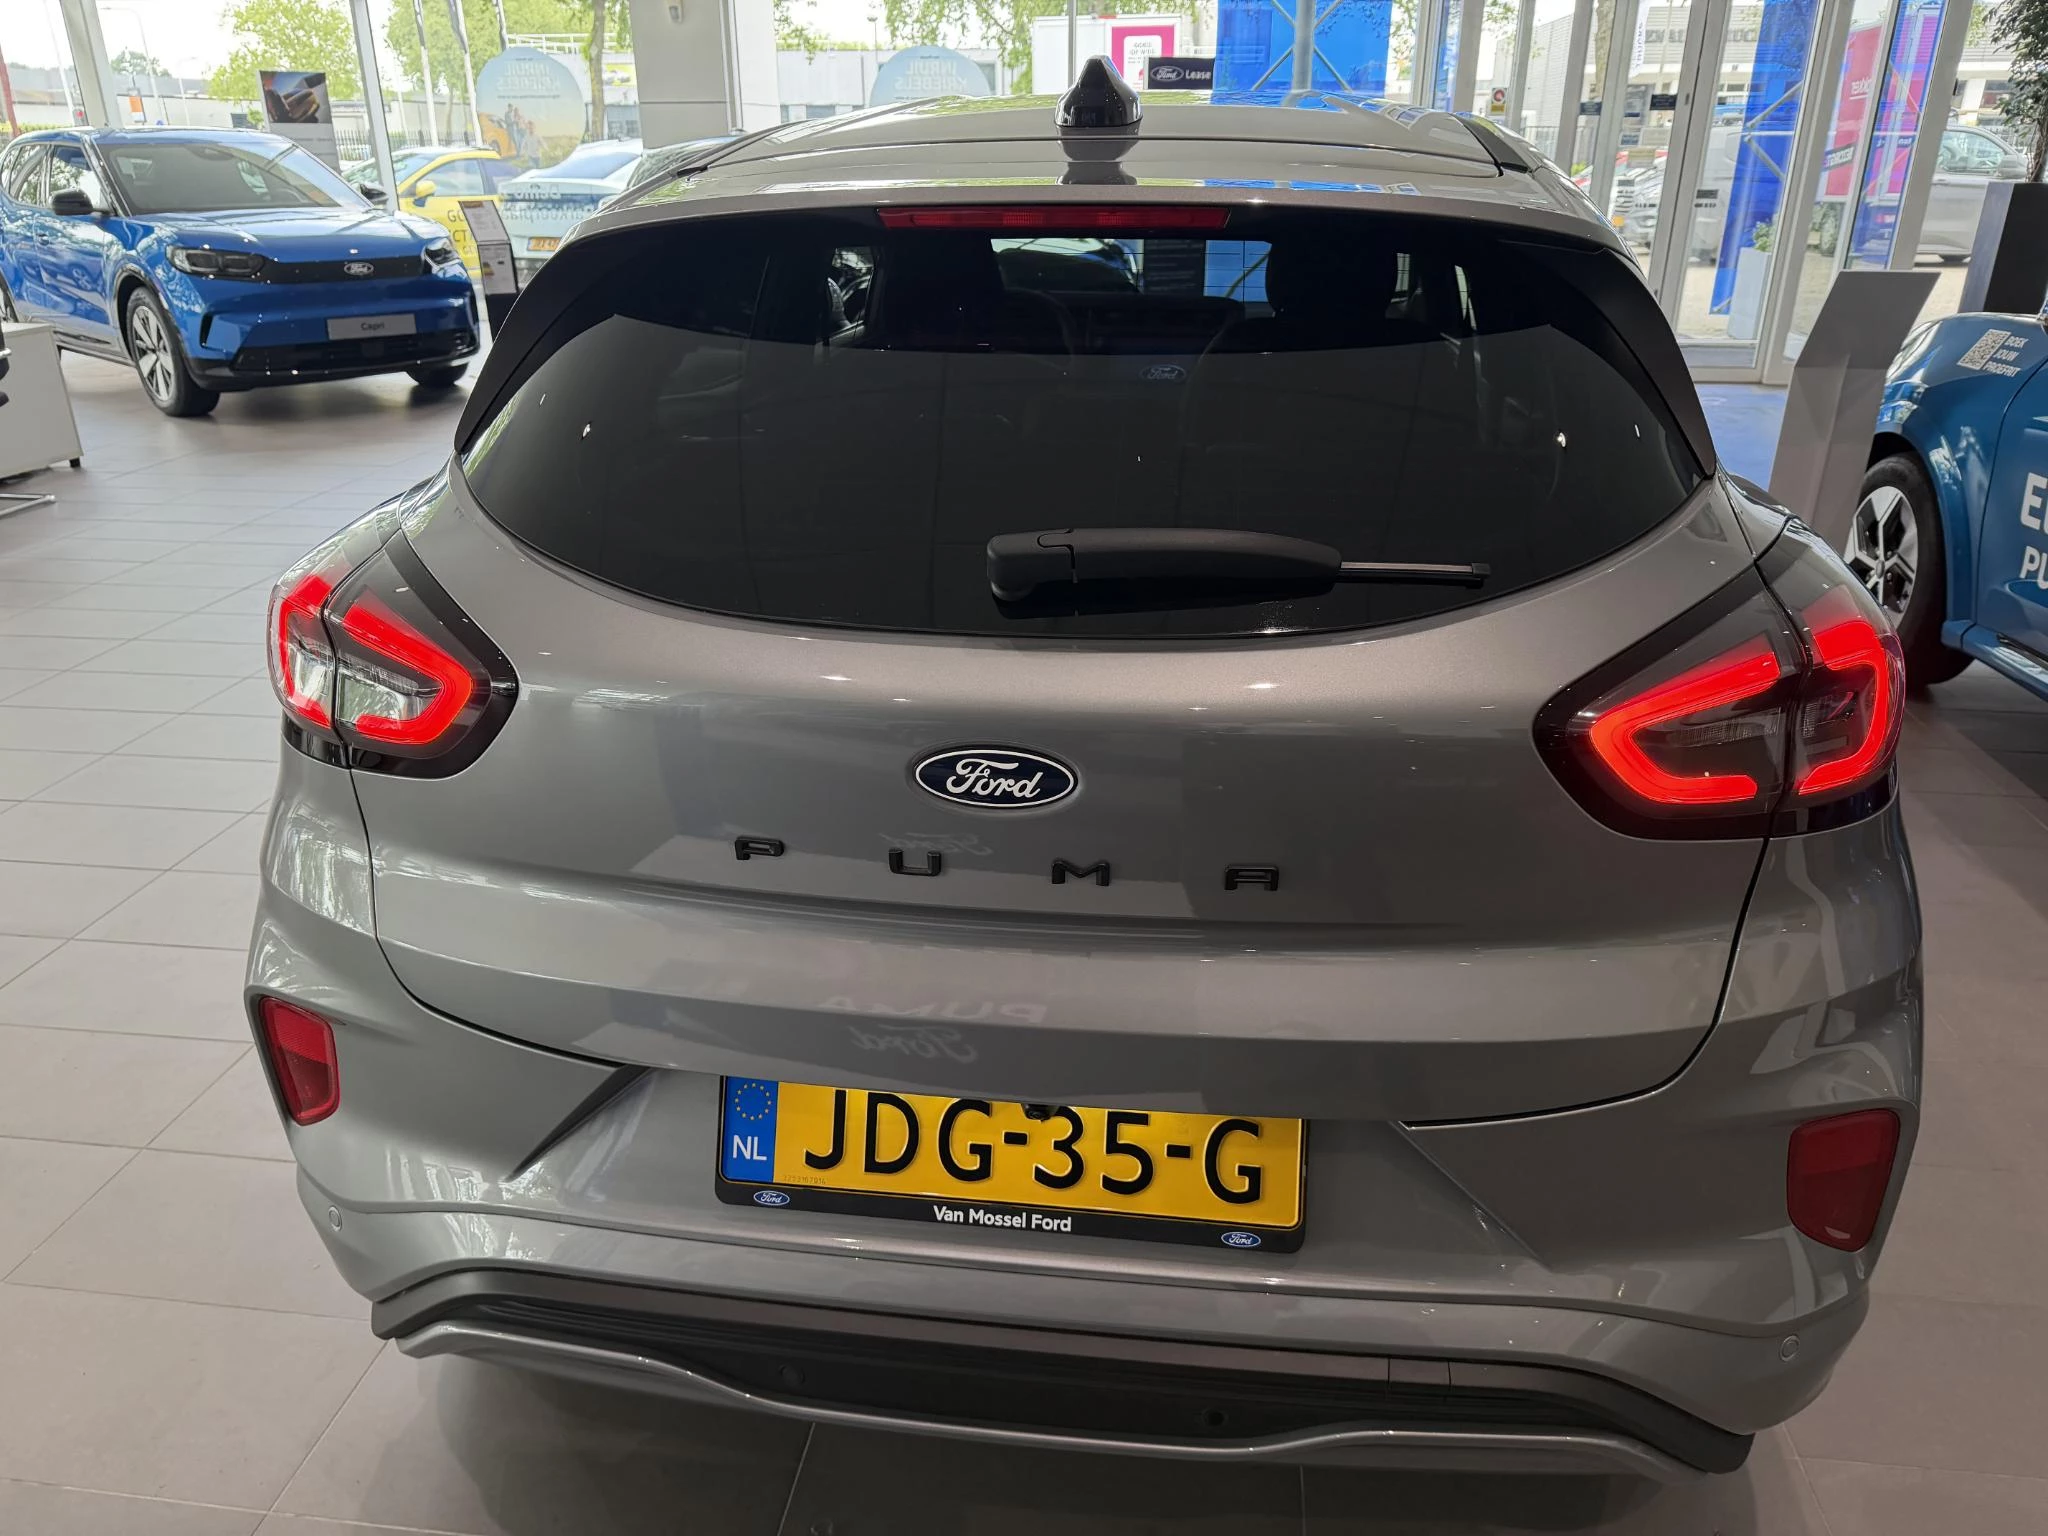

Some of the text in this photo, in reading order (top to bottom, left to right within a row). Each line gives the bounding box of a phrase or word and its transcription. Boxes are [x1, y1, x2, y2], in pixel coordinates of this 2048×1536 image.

[1156, 67, 1211, 81] Ford Lease
[360, 322, 385, 332] Capri
[2004, 335, 2029, 348] BOEK
[1993, 349, 2019, 361] JOUW
[944, 758, 1043, 798] Ford
[734, 835, 1280, 892] PUMA
[732, 1135, 768, 1161] NL
[804, 1089, 1262, 1205] JDG-35-G
[932, 1205, 1073, 1232] Van Mossel Ford
